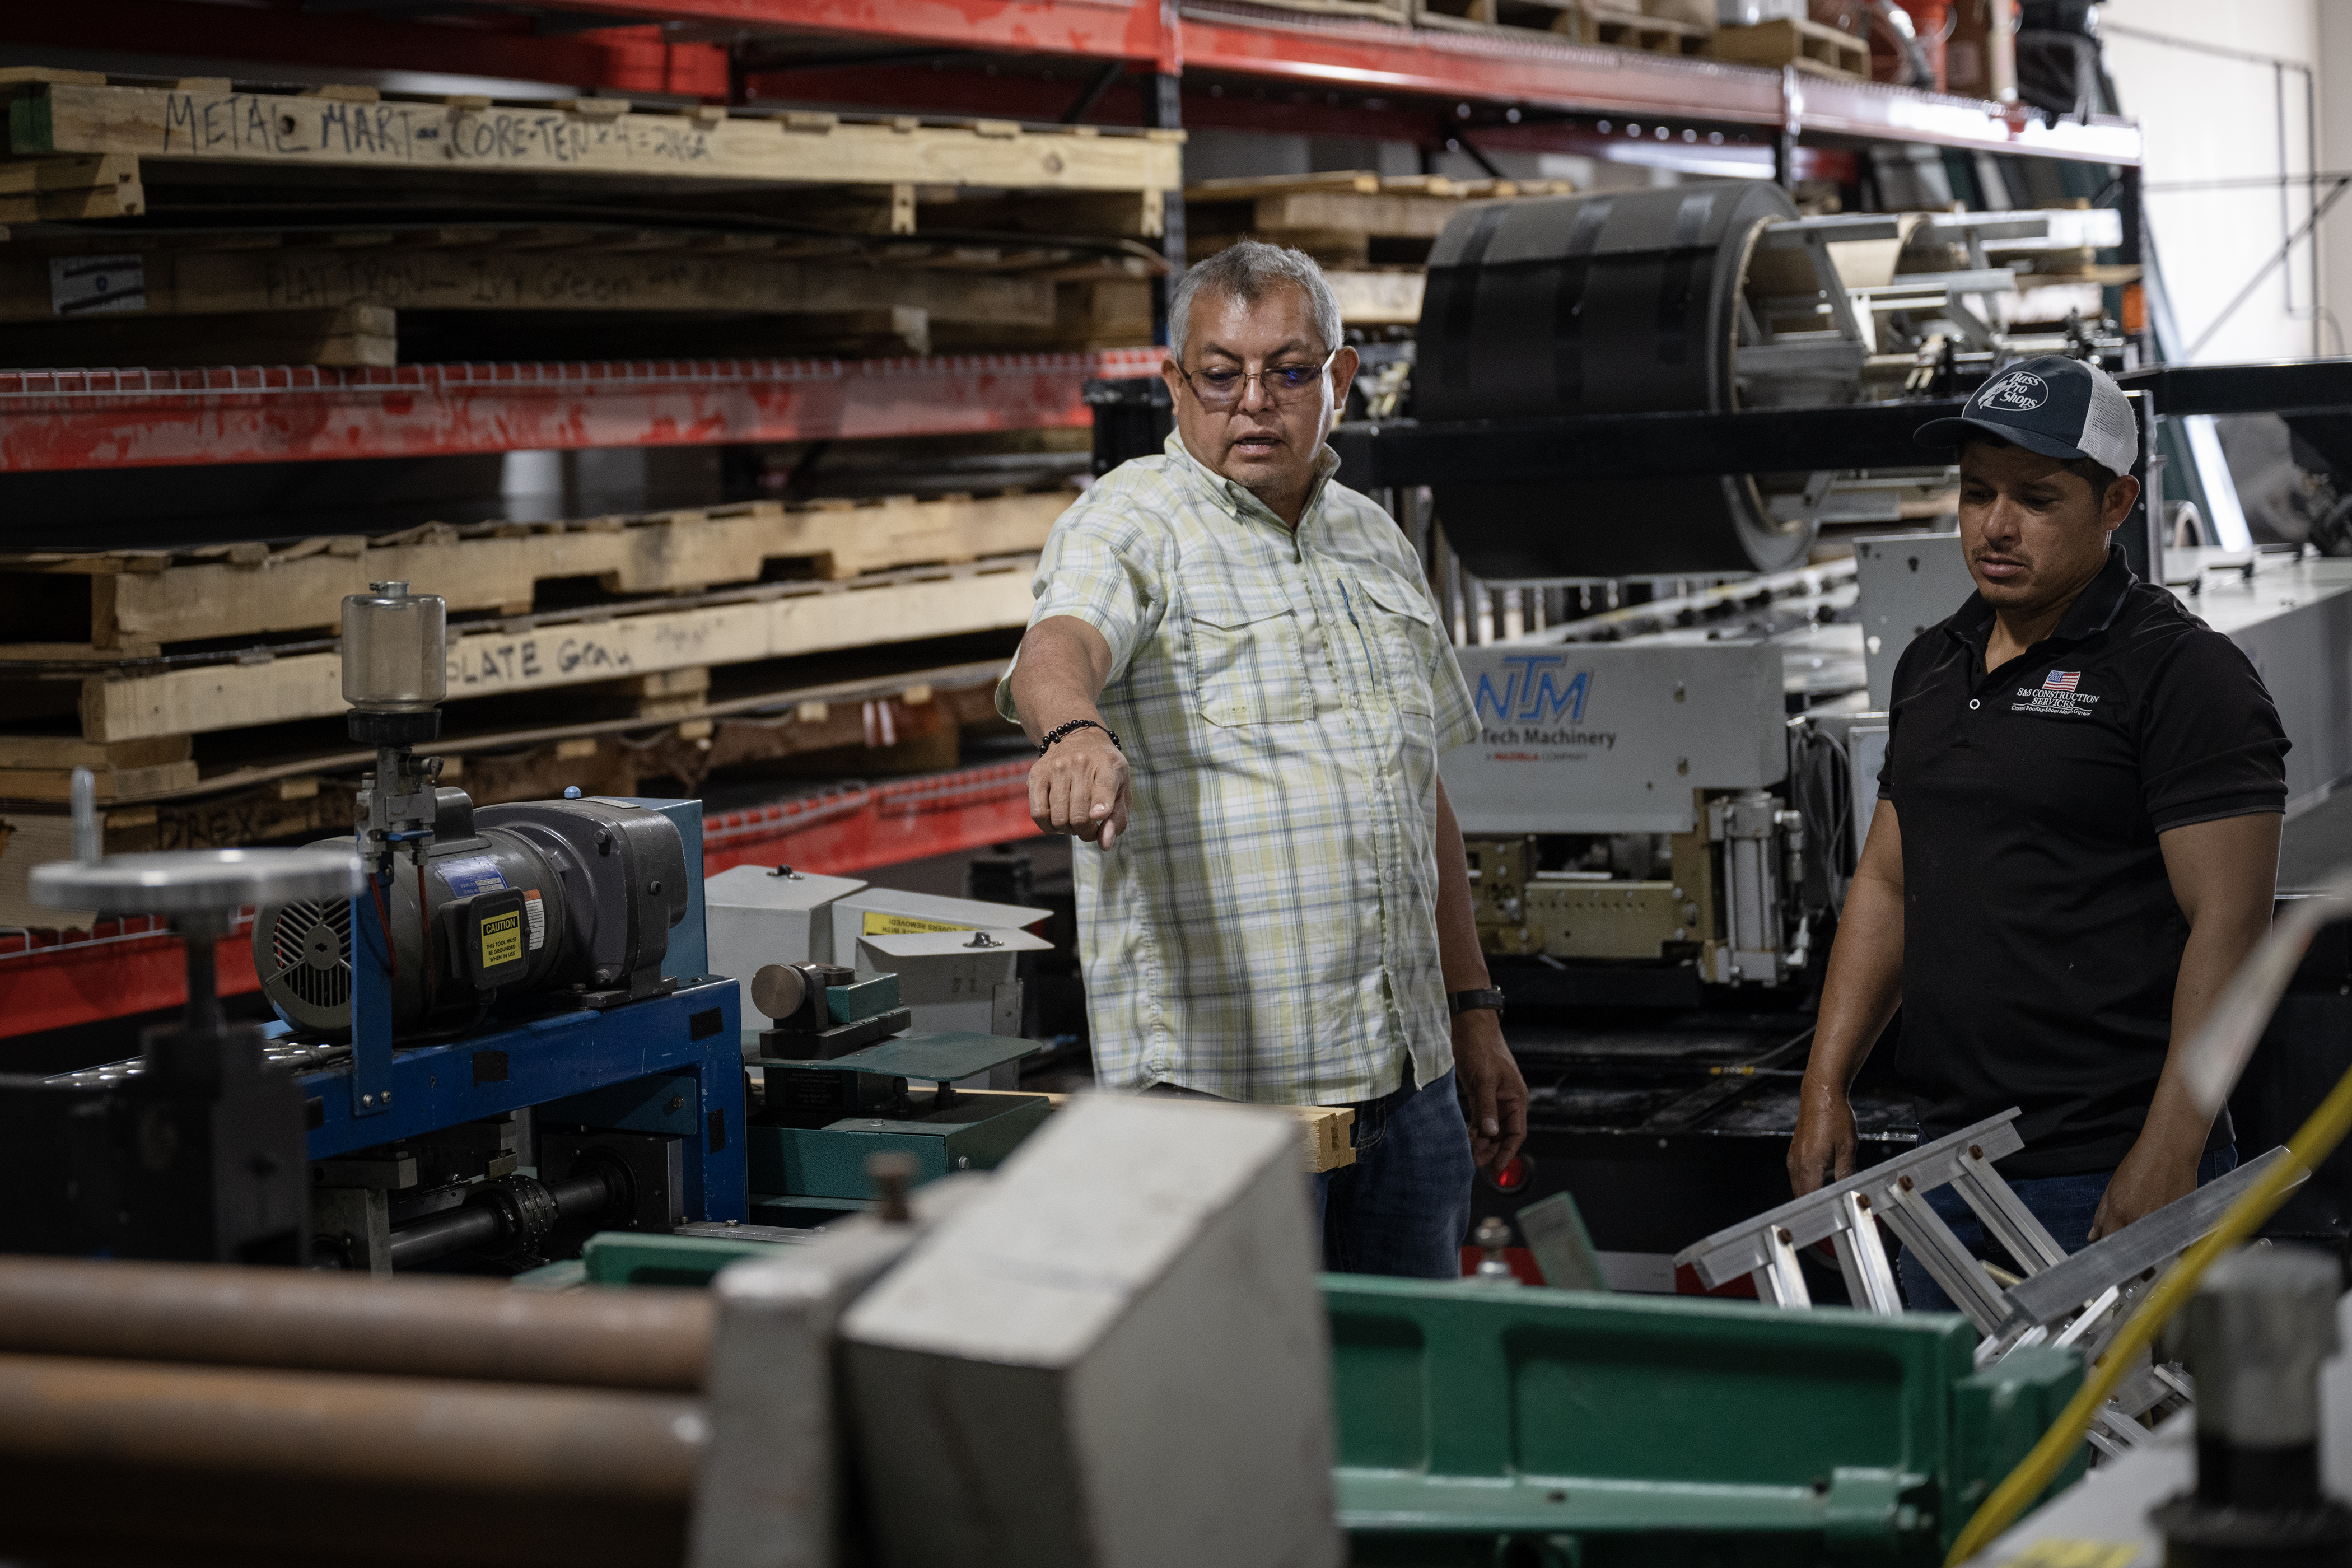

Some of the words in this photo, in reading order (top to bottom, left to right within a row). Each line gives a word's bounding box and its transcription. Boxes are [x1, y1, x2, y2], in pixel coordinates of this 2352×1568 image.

[164, 93, 309, 156] METAL
[321, 102, 412, 164] MART
[2008, 372, 2041, 386] Bass
[2004, 382, 2028, 394] Pro
[1999, 391, 2038, 409] Shops
[1475, 655, 1594, 722] NTM
[2017, 687, 2033, 697] S&S
[2032, 689, 2101, 703] CONSTRUCTION
[2031, 697, 2076, 709] SERVICES
[1482, 727, 1520, 745] Tech
[1523, 727, 1618, 750] Machinery
[486, 917, 515, 934] CAUTION
[882, 926, 900, 935] WITH
[889, 918, 926, 930] REMOVED!
[494, 944, 516, 954] GROUNDED
